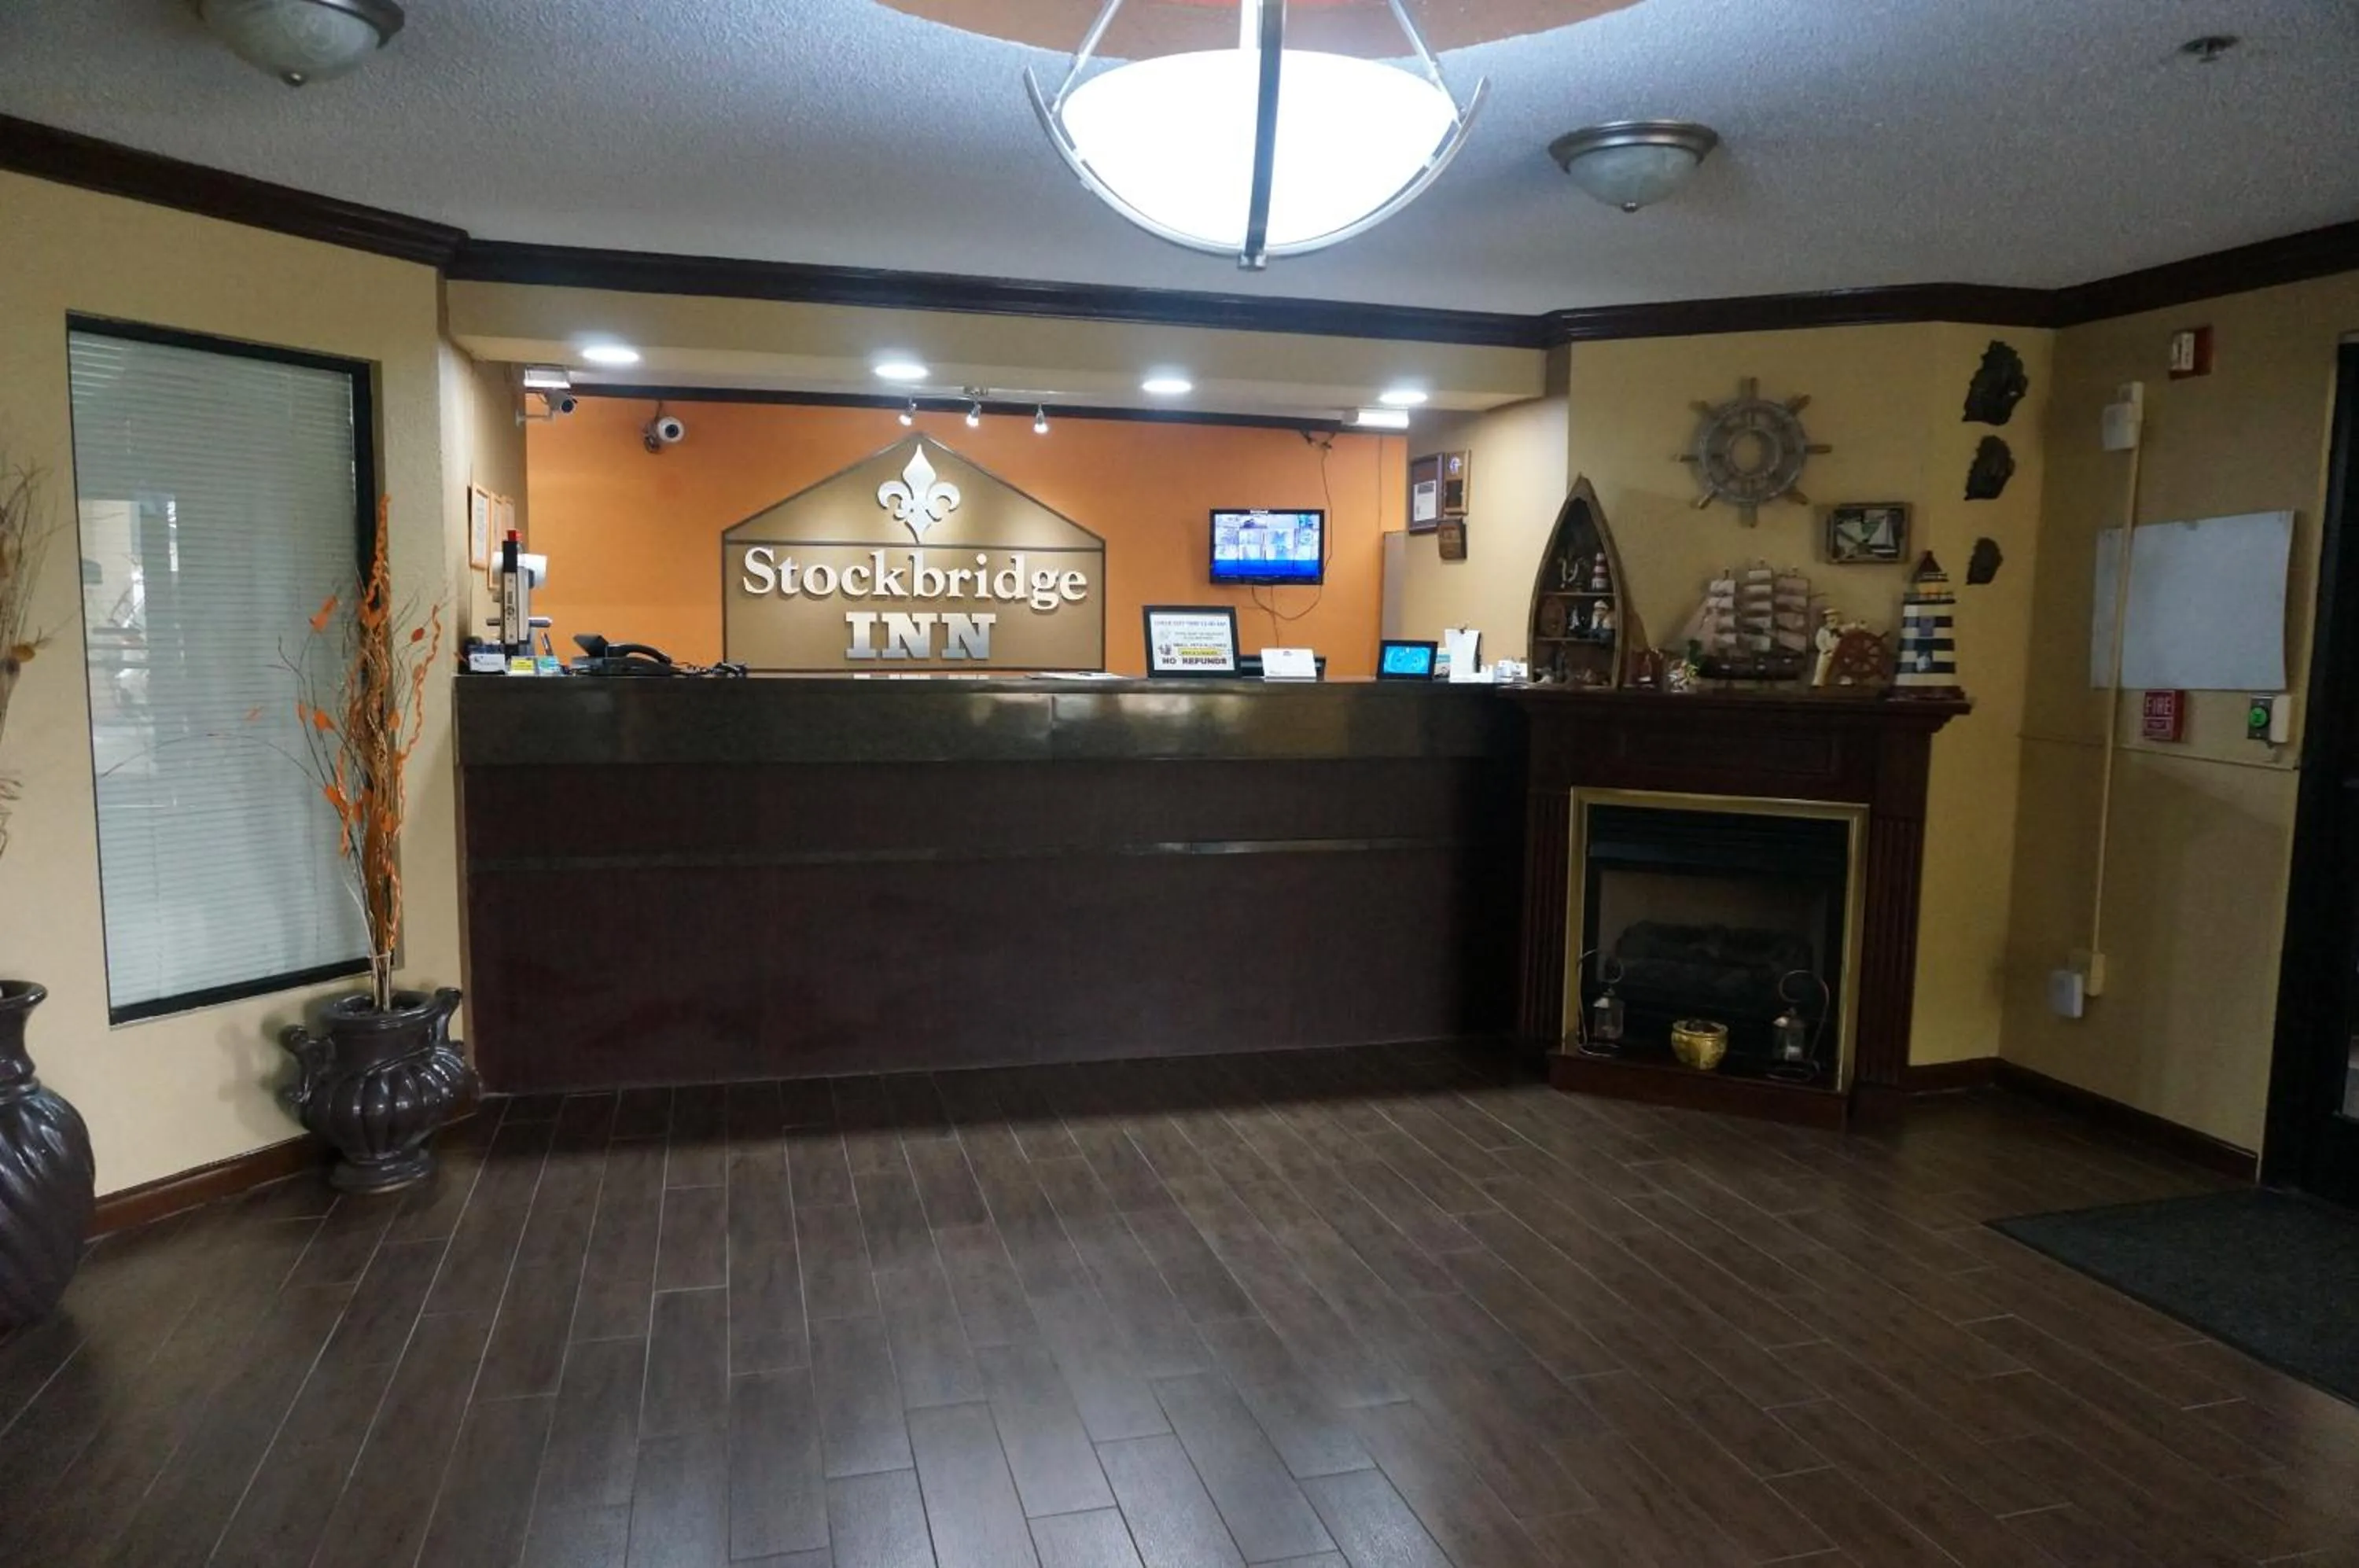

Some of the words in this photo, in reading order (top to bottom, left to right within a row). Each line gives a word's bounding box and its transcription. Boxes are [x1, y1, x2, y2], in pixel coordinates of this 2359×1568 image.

[743, 546, 1088, 611] Stockbridge
[845, 611, 996, 661] INN
[1161, 657, 1177, 665] NO
[1182, 657, 1227, 665] REFUNDS
[2146, 696, 2172, 715] FIRE
